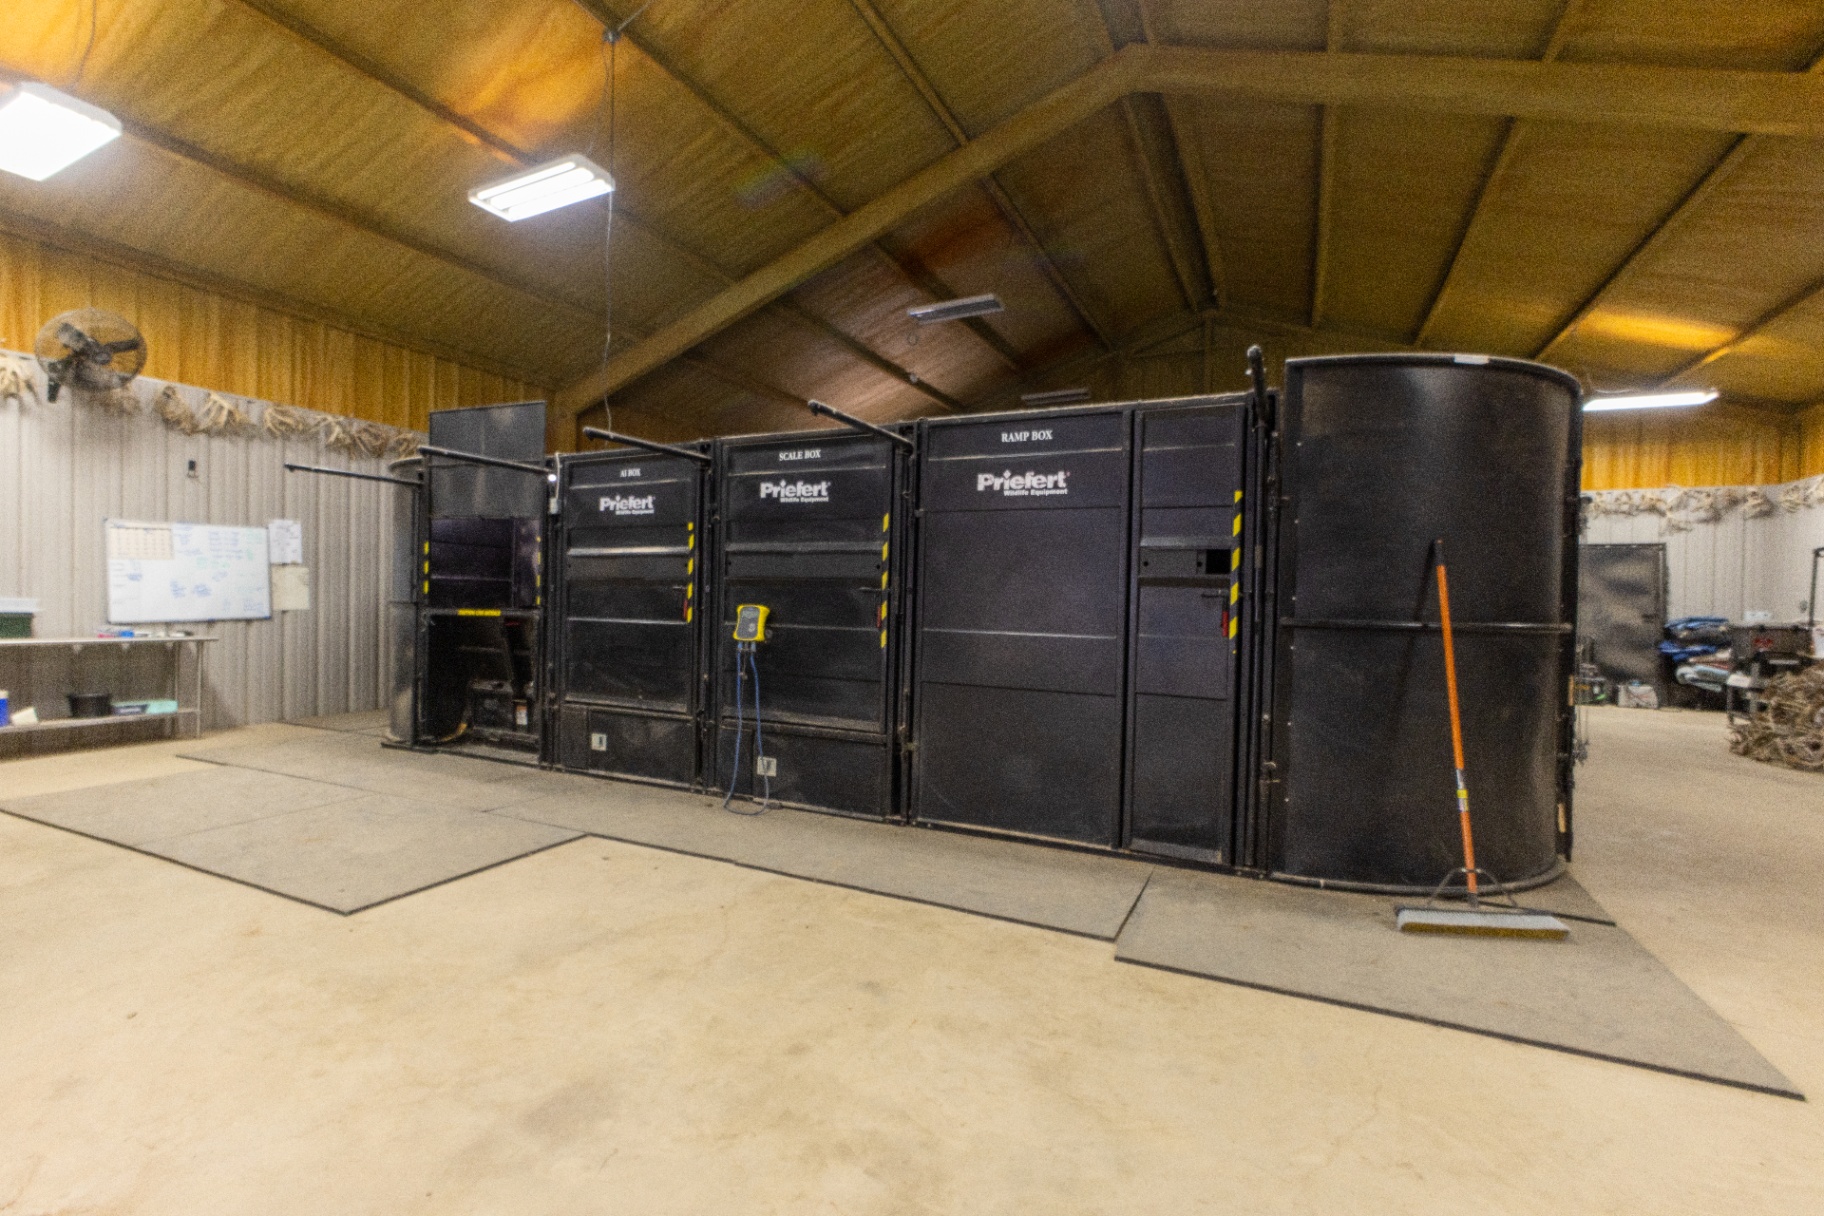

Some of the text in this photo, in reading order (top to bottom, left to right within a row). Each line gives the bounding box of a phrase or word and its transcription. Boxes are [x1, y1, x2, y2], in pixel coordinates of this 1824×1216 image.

[1001, 430, 1053, 442] RAMP BOX
[779, 449, 821, 461] SCALE BOX
[977, 469, 1067, 491] Priefert
[760, 480, 828, 498] Priefert
[1030, 488, 1068, 496] Equipment
[599, 495, 654, 511] Priefert
